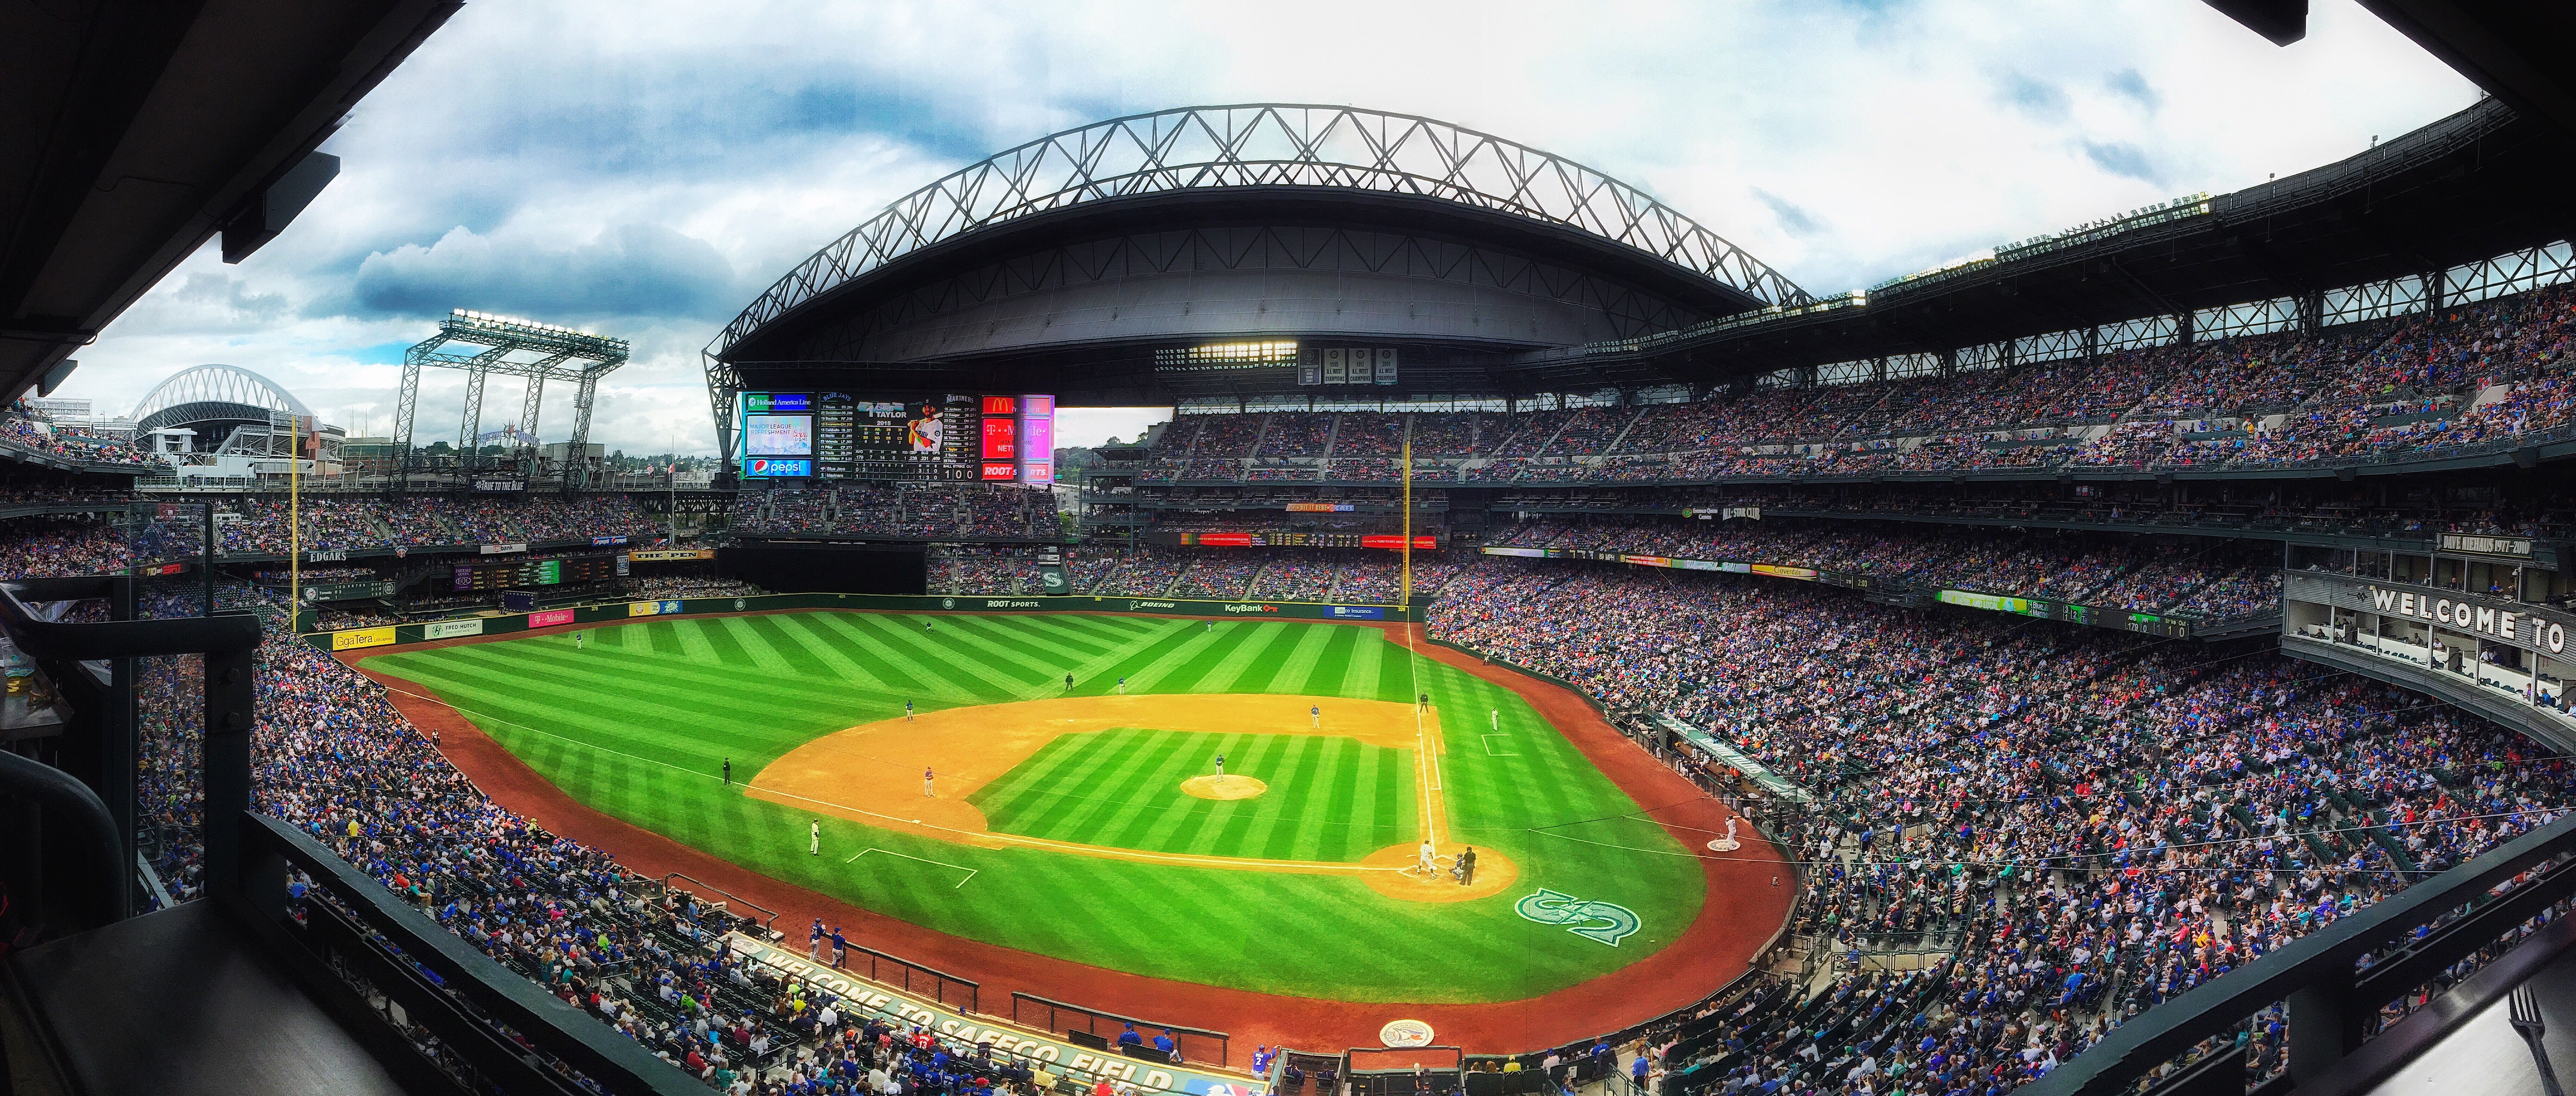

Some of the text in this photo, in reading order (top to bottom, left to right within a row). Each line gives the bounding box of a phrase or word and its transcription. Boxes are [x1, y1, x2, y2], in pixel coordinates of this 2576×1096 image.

[838, 393, 851, 401] JAYS
[946, 395, 974, 403] MARINERS
[866, 405, 873, 417] 1
[516, 430, 540, 447] MARINERS
[771, 462, 801, 474] pepsi
[984, 467, 1012, 475] ROOT
[945, 470, 973, 479] 1 0 0
[482, 480, 524, 490] TRUE TO THE BLUE
[1747, 507, 1760, 521] CLUB
[2443, 535, 2461, 549] DAVE
[2462, 537, 2494, 553] NIEHAUS
[147, 567, 157, 577] 710
[163, 563, 181, 575] ESPN
[1774, 566, 1801, 575] Cloverdale
[1858, 579, 1867, 587] 2:03
[1225, 604, 1263, 614] KeyBank
[1972, 600, 2000, 611] AND LOCAL
[2373, 589, 2565, 653] WELCOME TO
[2126, 622, 2138, 631] .179
[2168, 625, 2171, 636] 1
[2179, 627, 2184, 637] 0
[764, 952, 1173, 1093] WELCOME TO SAFECO FIELD
[919, 1041, 927, 1049] 13
